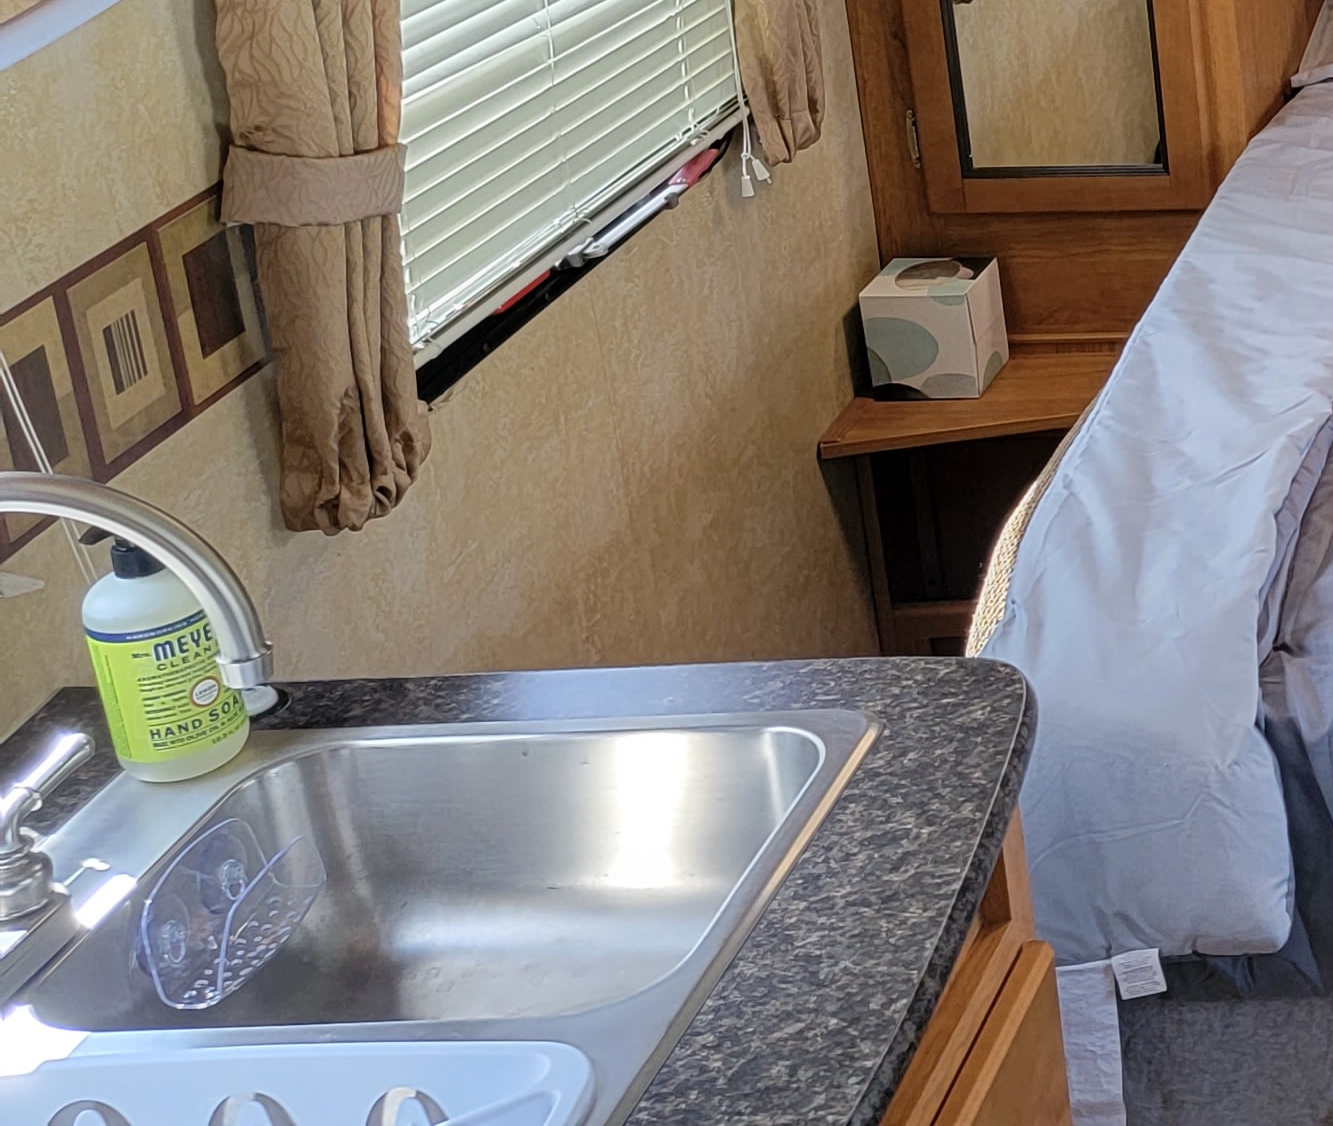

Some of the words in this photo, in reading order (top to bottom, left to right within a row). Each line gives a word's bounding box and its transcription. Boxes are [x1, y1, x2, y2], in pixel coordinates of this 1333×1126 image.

[153, 623, 214, 662] MEYE
[157, 646, 212, 671] CLEAN
[149, 718, 203, 740] HAND
